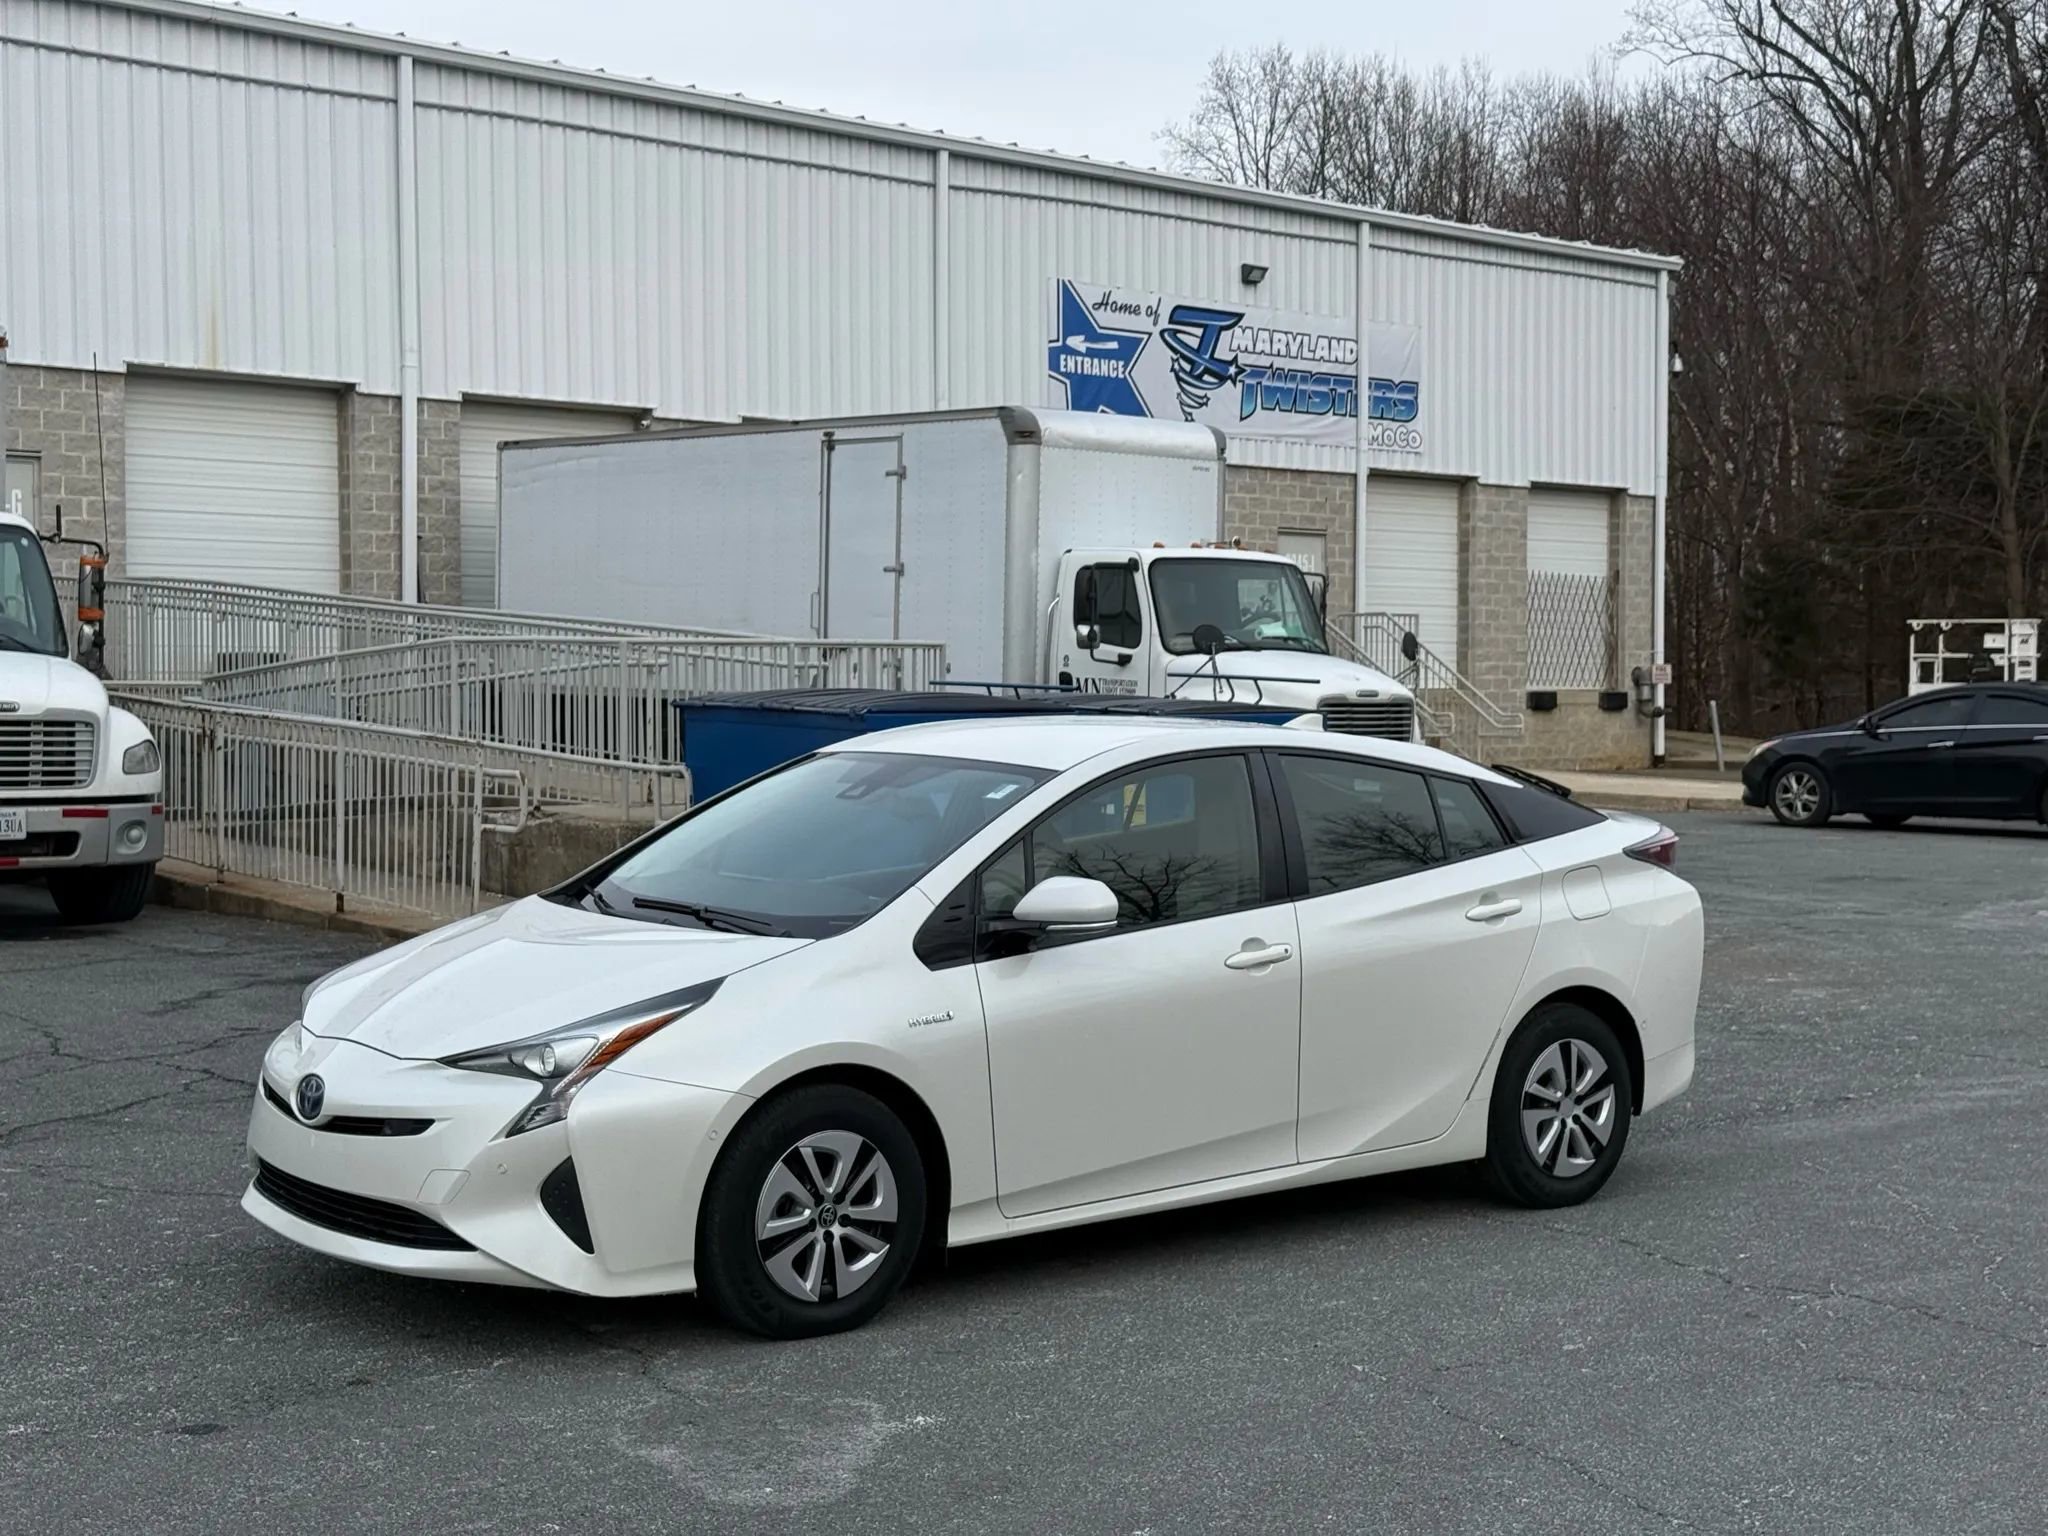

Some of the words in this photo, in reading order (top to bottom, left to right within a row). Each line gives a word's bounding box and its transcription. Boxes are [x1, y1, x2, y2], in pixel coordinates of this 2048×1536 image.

[1092, 290, 1141, 316] Home
[1145, 296, 1161, 327] of
[1229, 325, 1358, 365] MARYLAND
[1060, 354, 1125, 379] ENTRANCE
[908, 1011, 946, 1028] HYBRID
